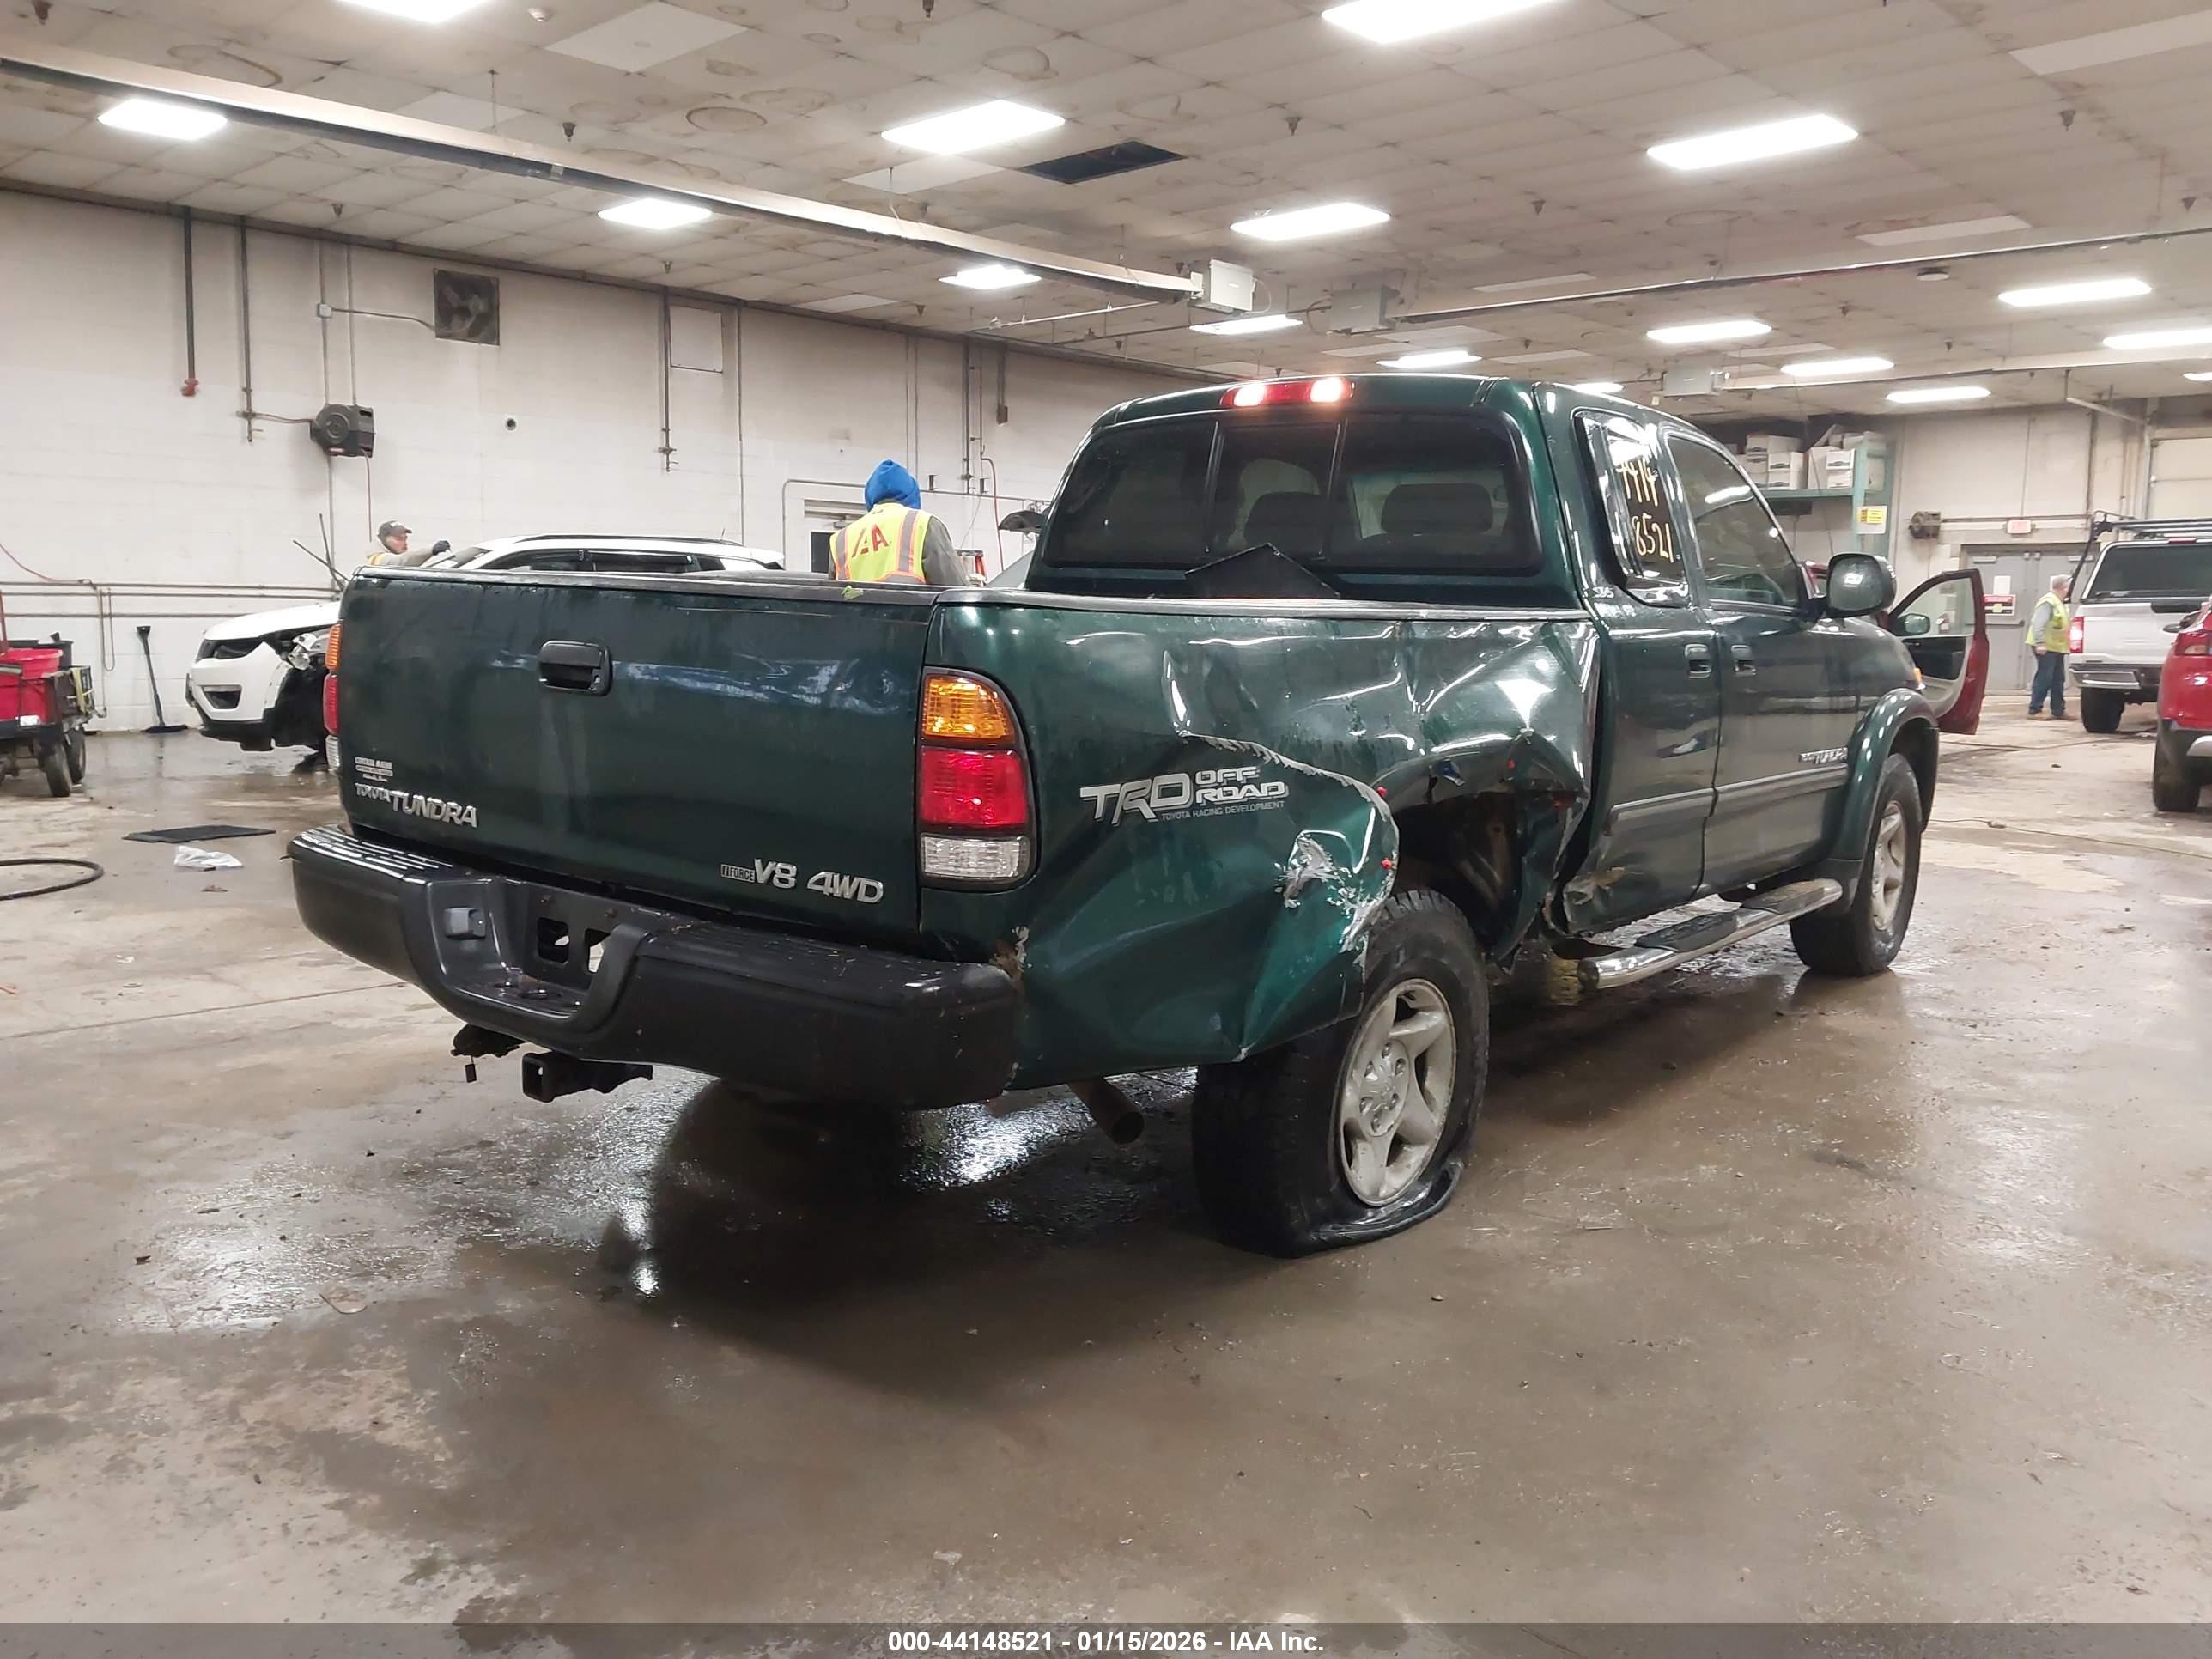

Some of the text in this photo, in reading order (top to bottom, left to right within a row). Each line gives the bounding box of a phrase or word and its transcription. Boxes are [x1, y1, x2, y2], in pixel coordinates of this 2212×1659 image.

[1195, 766, 1261, 786] OFF
[1195, 781, 1289, 805] ROAD
[355, 782, 477, 829] TOYOTA TUNDRA
[1079, 773, 1194, 827] TRD
[1162, 800, 1285, 821] TOYOTA RACING DEVELOPMENT
[754, 859, 797, 889] V8
[806, 871, 884, 903] 4WD
